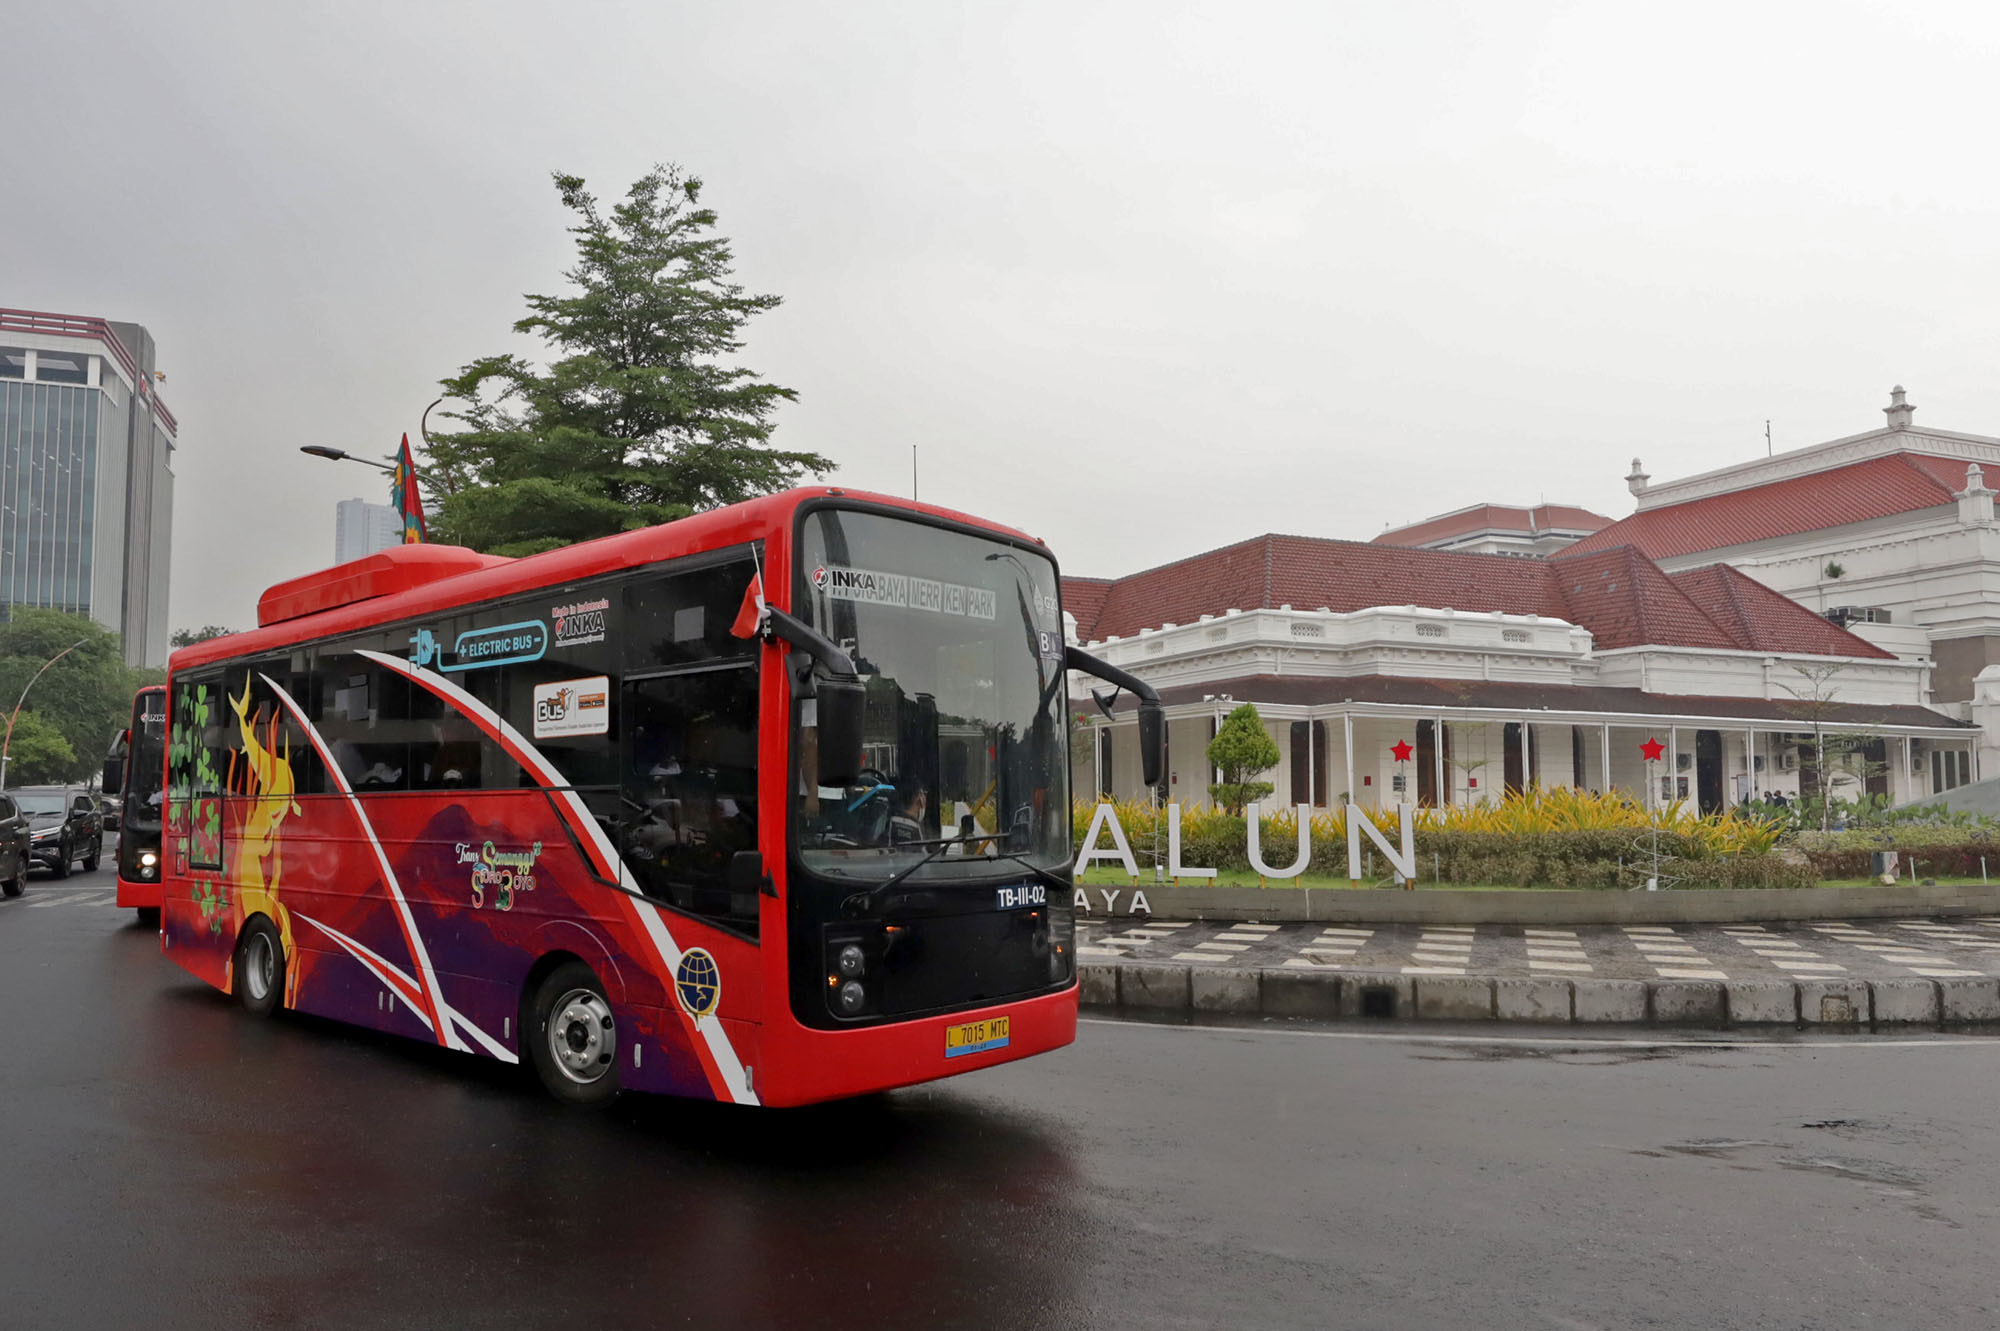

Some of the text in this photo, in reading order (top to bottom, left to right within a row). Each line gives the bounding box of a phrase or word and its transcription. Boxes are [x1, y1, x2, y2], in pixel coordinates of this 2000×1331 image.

[832, 570, 876, 590] INKA
[911, 580, 940, 608] MERR
[944, 586, 965, 612] KEN
[969, 589, 994, 616] PARK
[566, 611, 605, 637] INKA
[469, 635, 532, 657] ELECTRIC BUS
[1073, 803, 1417, 880] ALUN
[456, 841, 542, 875] Trans Semanggi
[998, 885, 1046, 907] TB-III-02
[948, 1019, 1008, 1047] L 7015 MTC
